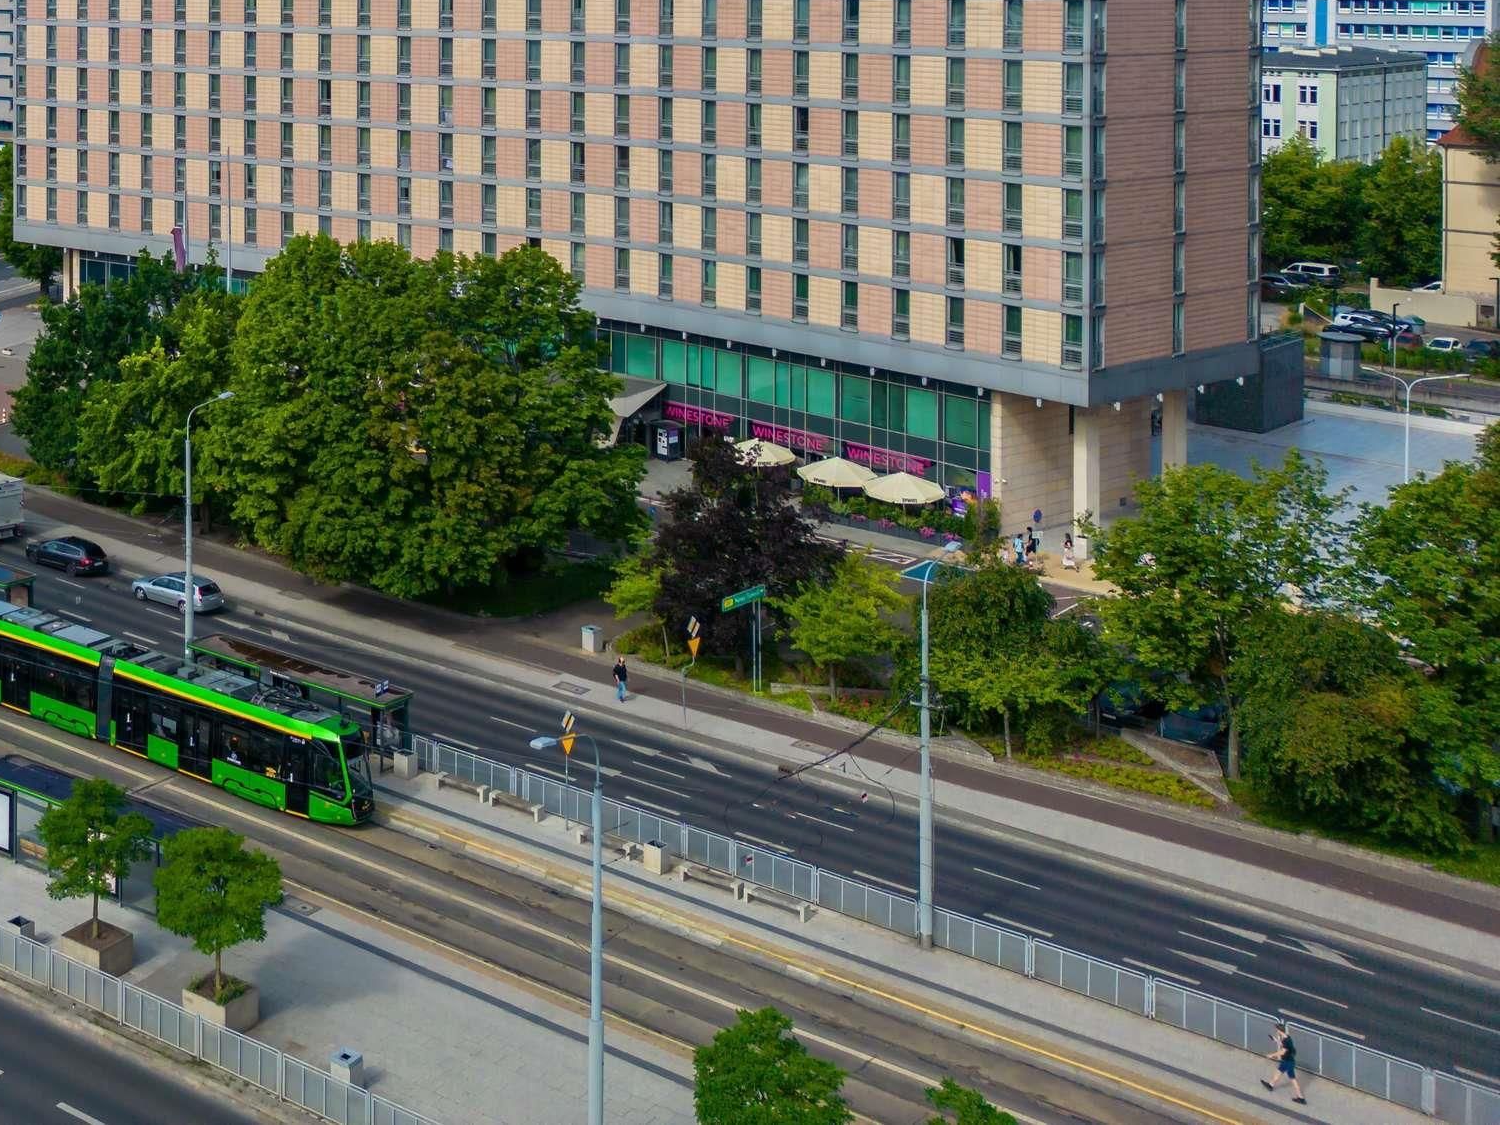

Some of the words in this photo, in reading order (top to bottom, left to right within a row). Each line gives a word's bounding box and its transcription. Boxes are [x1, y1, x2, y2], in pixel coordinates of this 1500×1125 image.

[667, 406, 729, 427] WINESTONE
[752, 425, 824, 451] WINESTONE
[846, 446, 925, 475] WINESTONE
